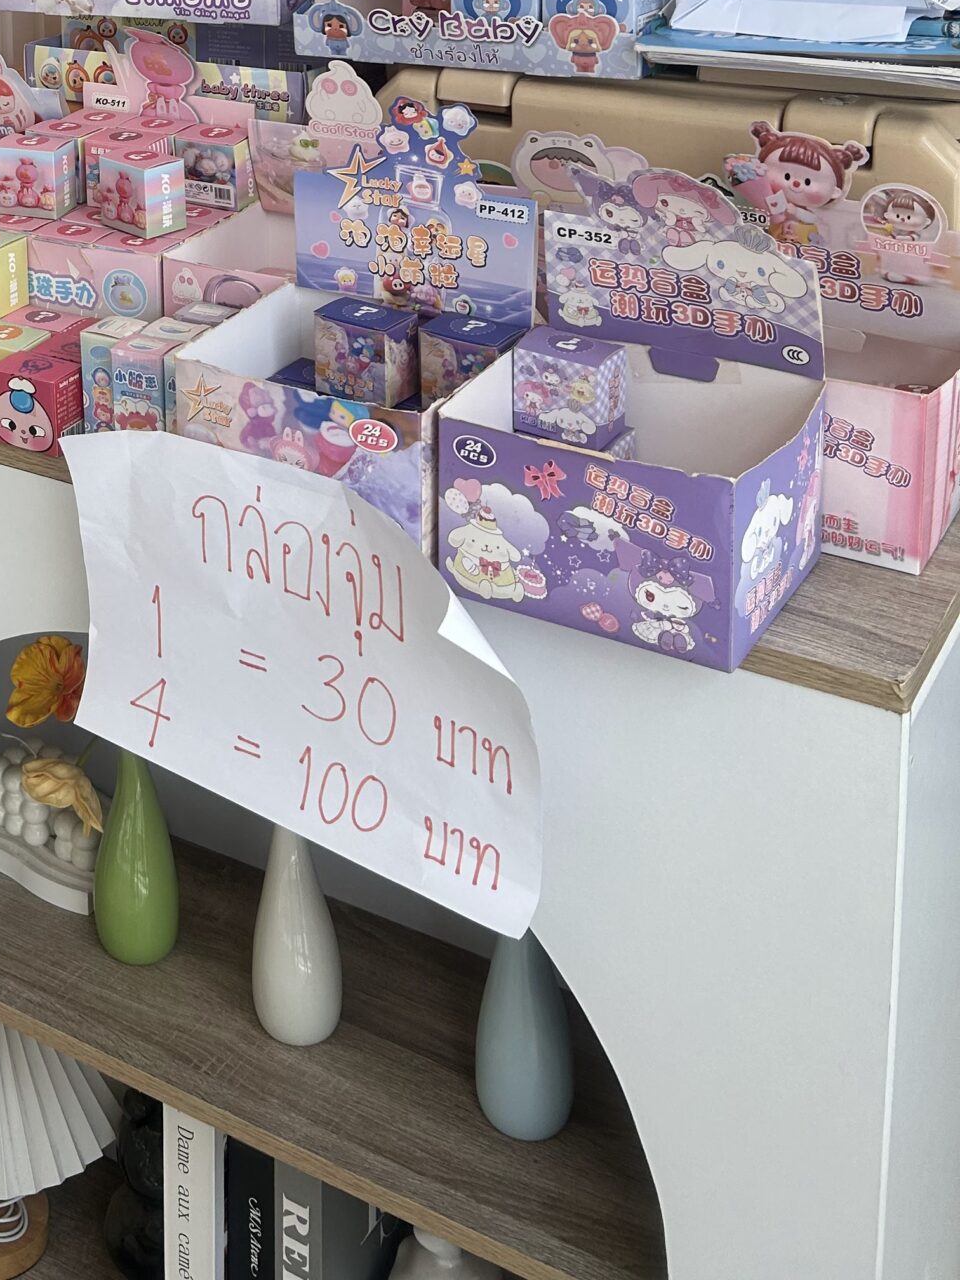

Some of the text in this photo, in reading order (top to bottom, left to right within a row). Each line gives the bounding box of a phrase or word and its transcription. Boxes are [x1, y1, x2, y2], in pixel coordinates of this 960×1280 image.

[174, 7, 250, 19] Yin Qing Angel
[369, 9, 543, 46] Cry Baby
[410, 44, 500, 65] ช้างร้องไห้
[95, 96, 127, 108] KO-511
[201, 79, 290, 102] baby three
[361, 175, 403, 193] Lucky
[361, 189, 404, 208] Star
[479, 204, 525, 219] PP-412
[340, 218, 488, 267] 泡泡幸运星
[556, 226, 613, 244] CP-352
[588, 257, 711, 303] 运势盲盒
[610, 290, 778, 344] 潮玩3D手办
[363, 424, 381, 437] 24
[464, 439, 481, 452] 24
[584, 463, 679, 522] 运势盲盒
[592, 489, 715, 562] 潮玩3D手办
[822, 513, 859, 535] 而生
[191, 484, 405, 657] กล่องจุ่ม
[151, 584, 163, 658] 1
[301, 653, 397, 746] 30
[433, 714, 512, 795] บาท
[130, 677, 171, 748] 4
[298, 745, 389, 832] 100
[422, 815, 501, 891] บาท
[177, 1125, 195, 1174] Dame
[177, 1184, 190, 1222] aux
